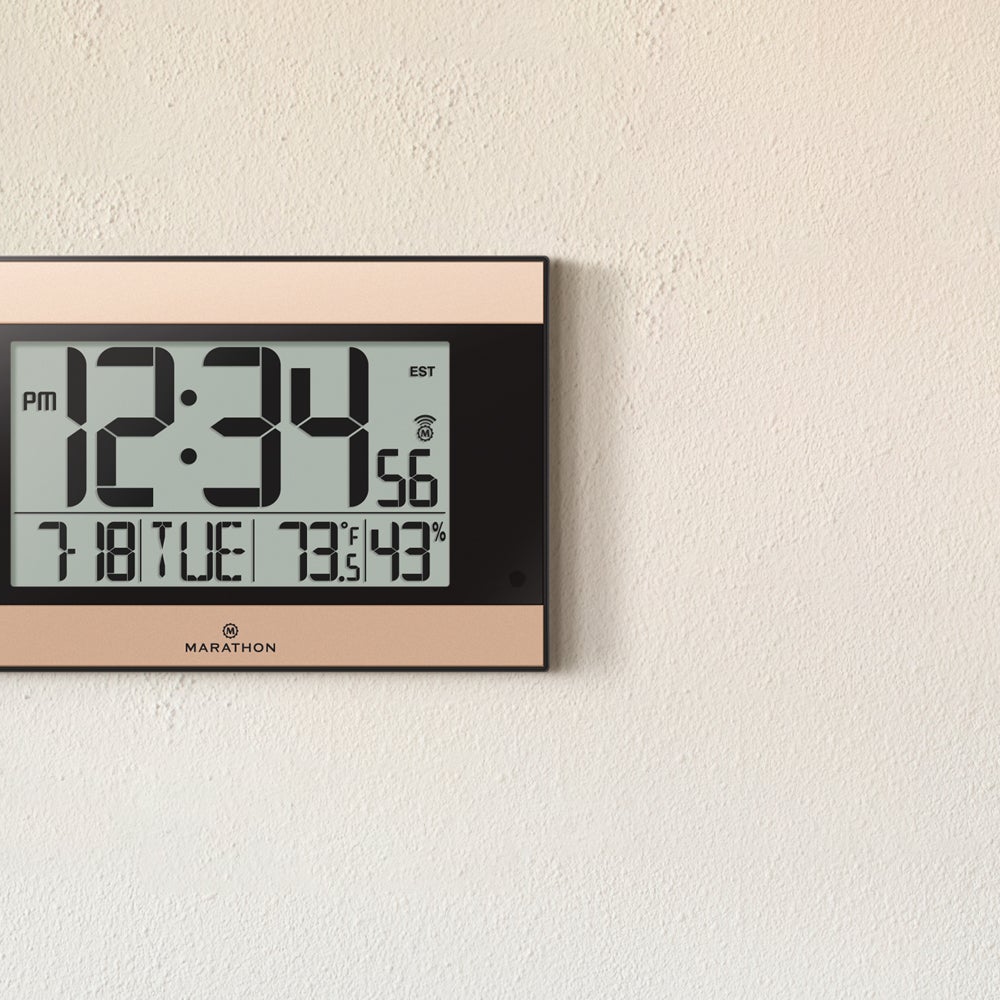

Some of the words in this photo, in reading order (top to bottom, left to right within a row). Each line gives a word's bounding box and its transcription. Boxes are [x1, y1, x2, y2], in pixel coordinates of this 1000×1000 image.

[410, 366, 436, 378] EST
[23, 391, 57, 411] PM
[67, 347, 369, 508] 12:34
[377, 449, 438, 508] 56
[152, 521, 245, 582] TUE
[185, 642, 276, 653] MARATHON
